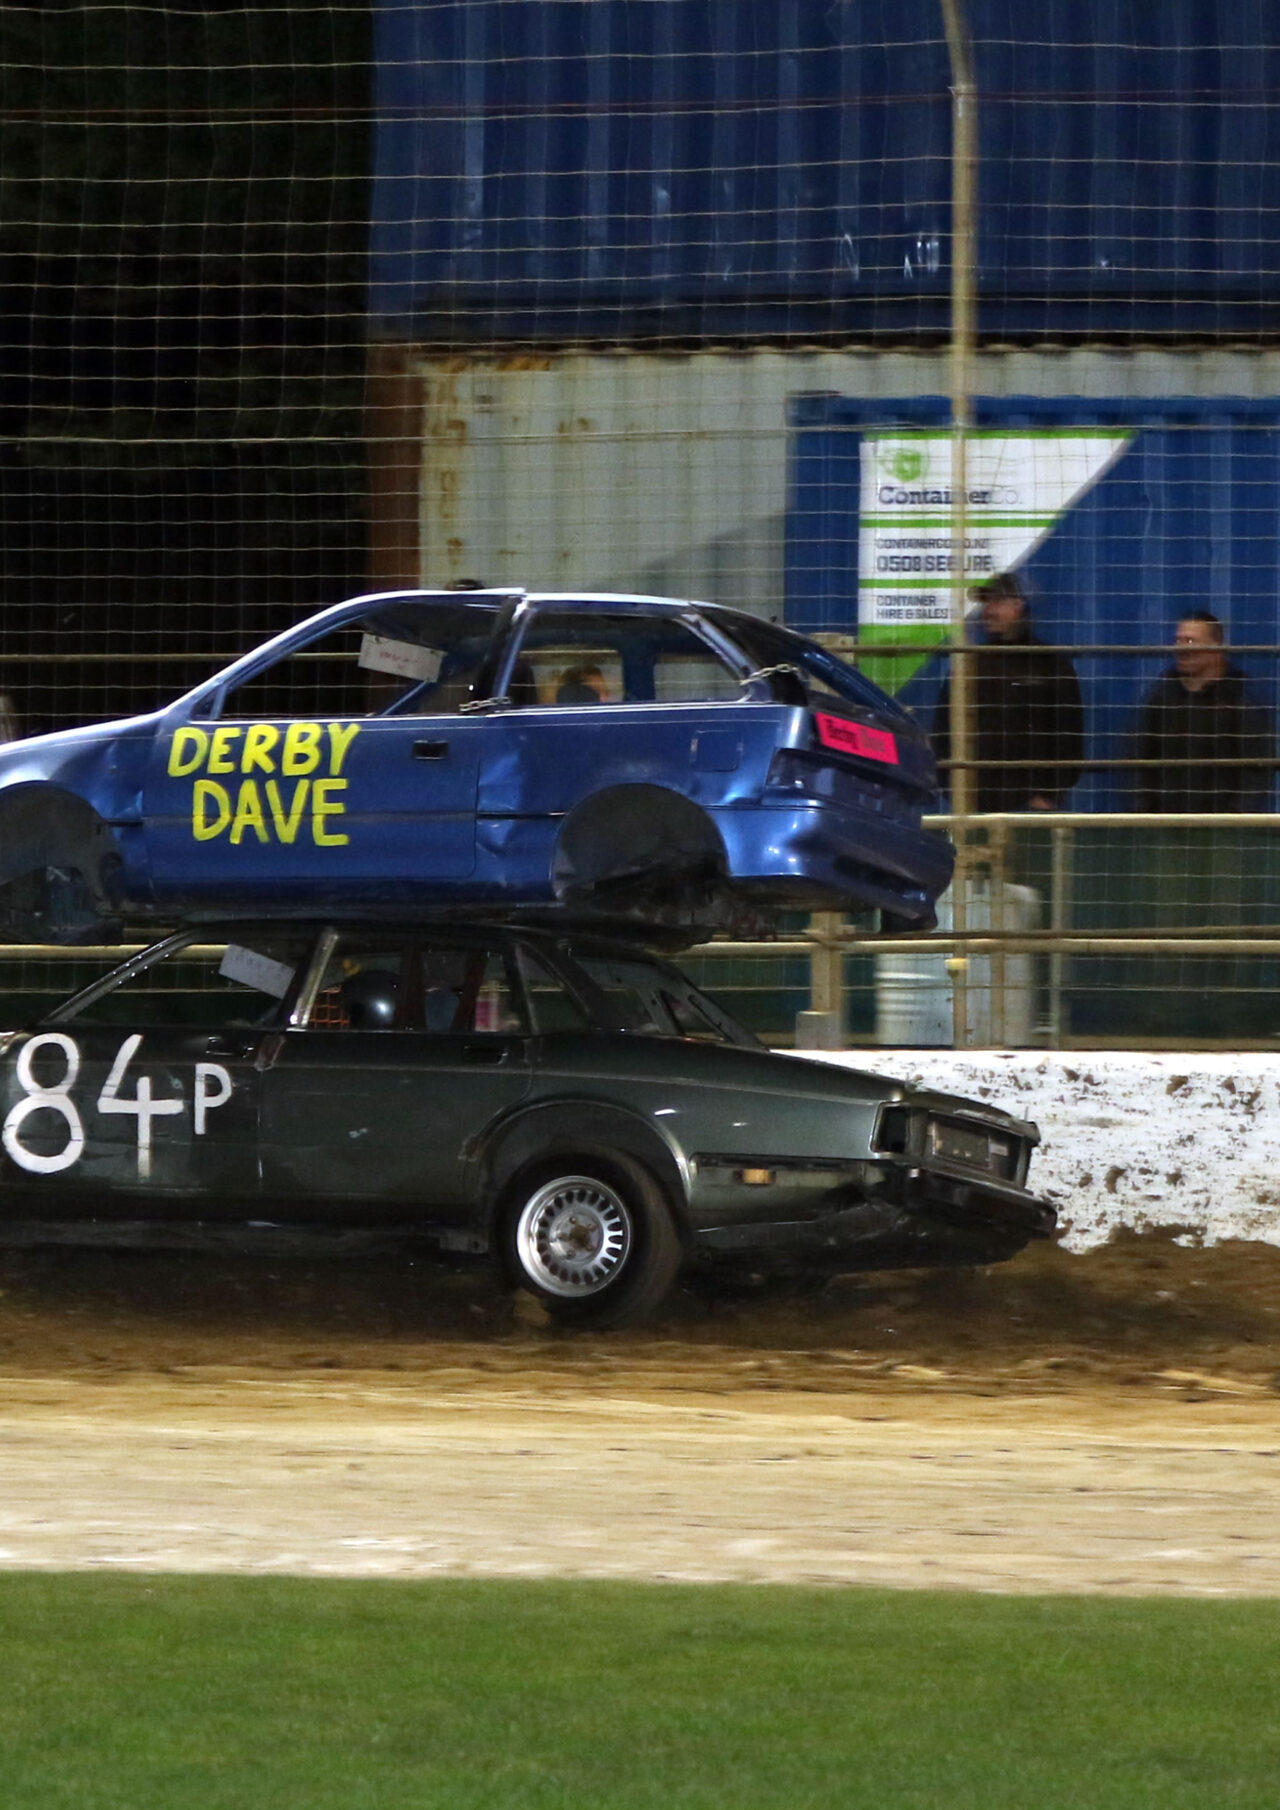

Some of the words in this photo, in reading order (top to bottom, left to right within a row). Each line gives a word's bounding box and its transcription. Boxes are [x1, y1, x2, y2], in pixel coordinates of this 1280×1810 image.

[877, 555, 921, 572] 0508
[877, 595, 936, 607] CONTAINER
[877, 608, 904, 619] HIRE
[906, 609, 914, 619] &
[916, 608, 949, 619] SALES
[167, 723, 361, 777] DERBY
[192, 778, 350, 846] DAVE
